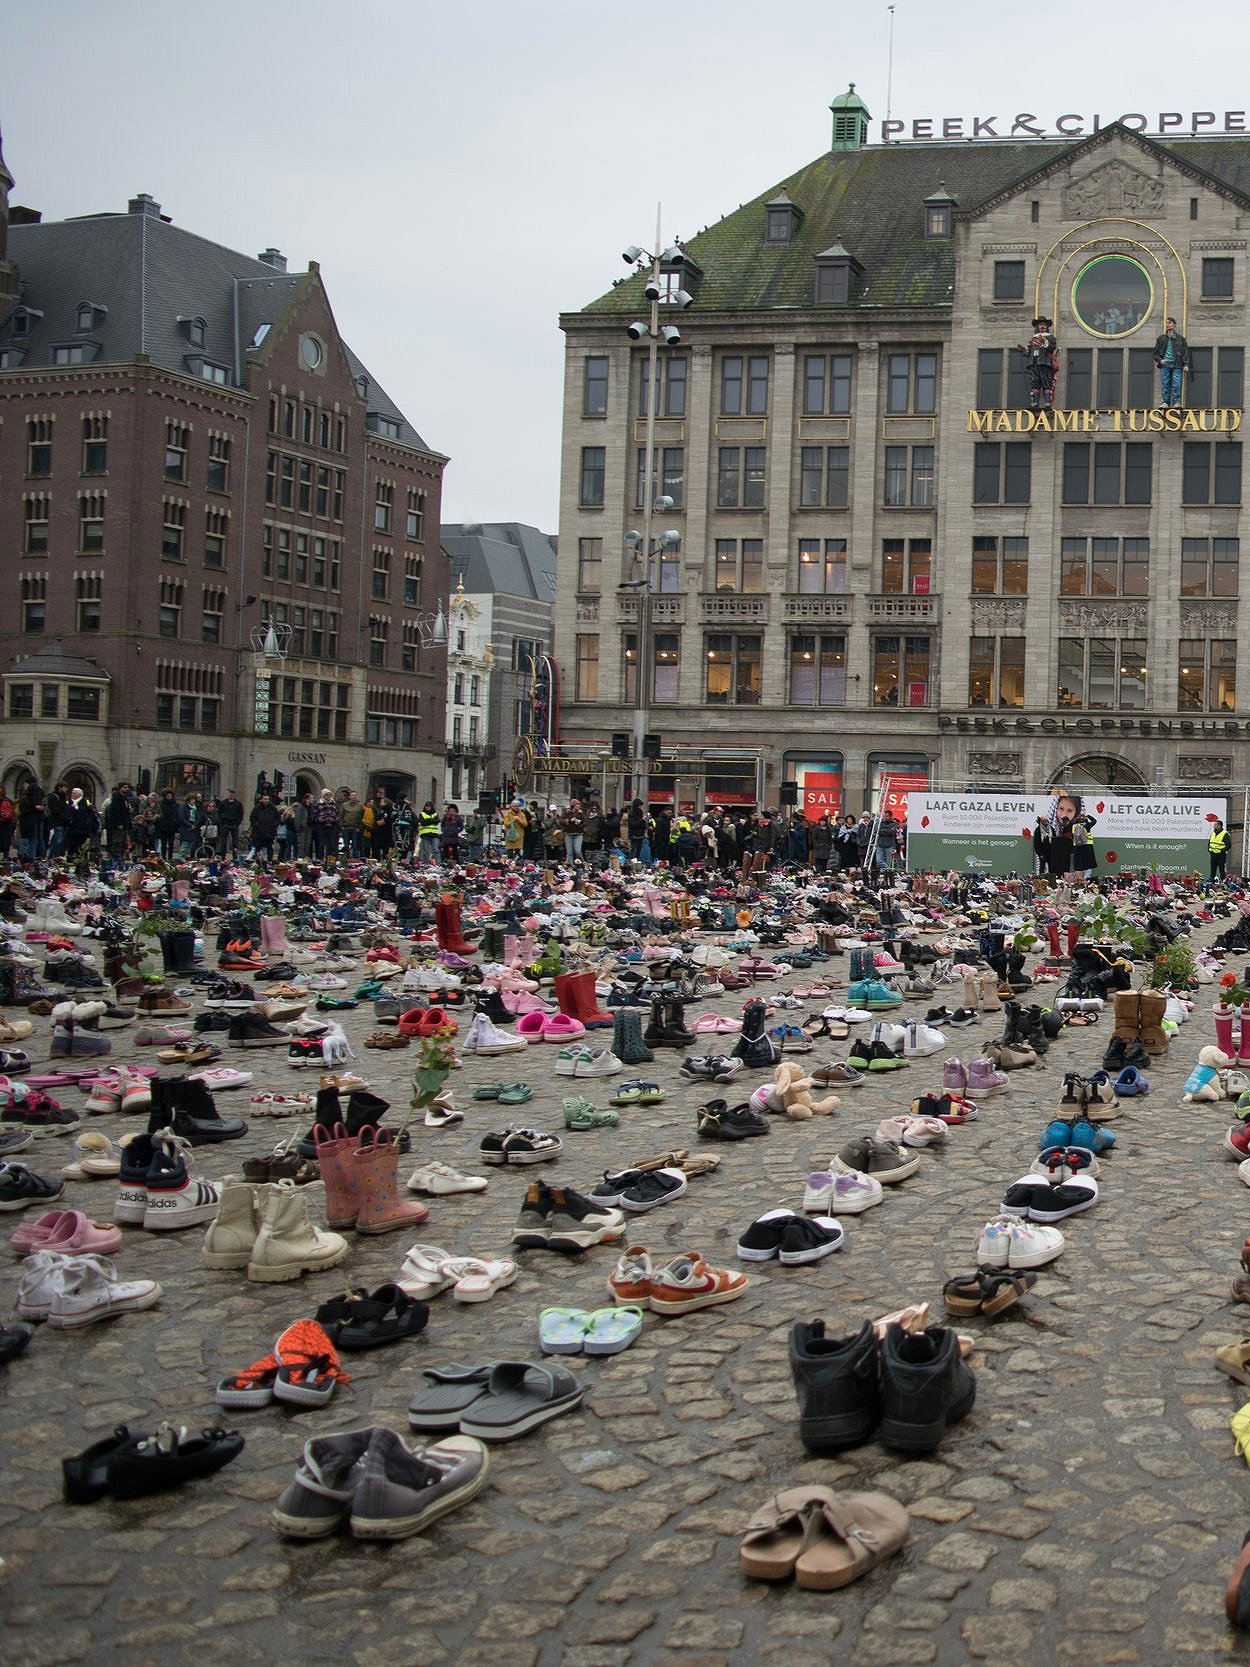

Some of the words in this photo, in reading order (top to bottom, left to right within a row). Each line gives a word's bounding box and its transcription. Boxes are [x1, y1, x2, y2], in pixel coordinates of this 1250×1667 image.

[968, 409, 1099, 432] MADAME
[1108, 408, 1241, 432] TUSSAUD
[288, 752, 326, 763] GASSAN
[541, 760, 598, 772] MADAME
[605, 761, 663, 773] TUSSD
[807, 793, 842, 804] SAL
[926, 801, 957, 811] LAAT
[959, 801, 992, 812] GAZA
[995, 802, 1035, 813] LEVEN
[1110, 804, 1133, 814] LET
[1136, 805, 1169, 815] GAZA
[1173, 805, 1200, 815] LIVE
[978, 838, 989, 846] het
[148, 1198, 178, 1208] didas
